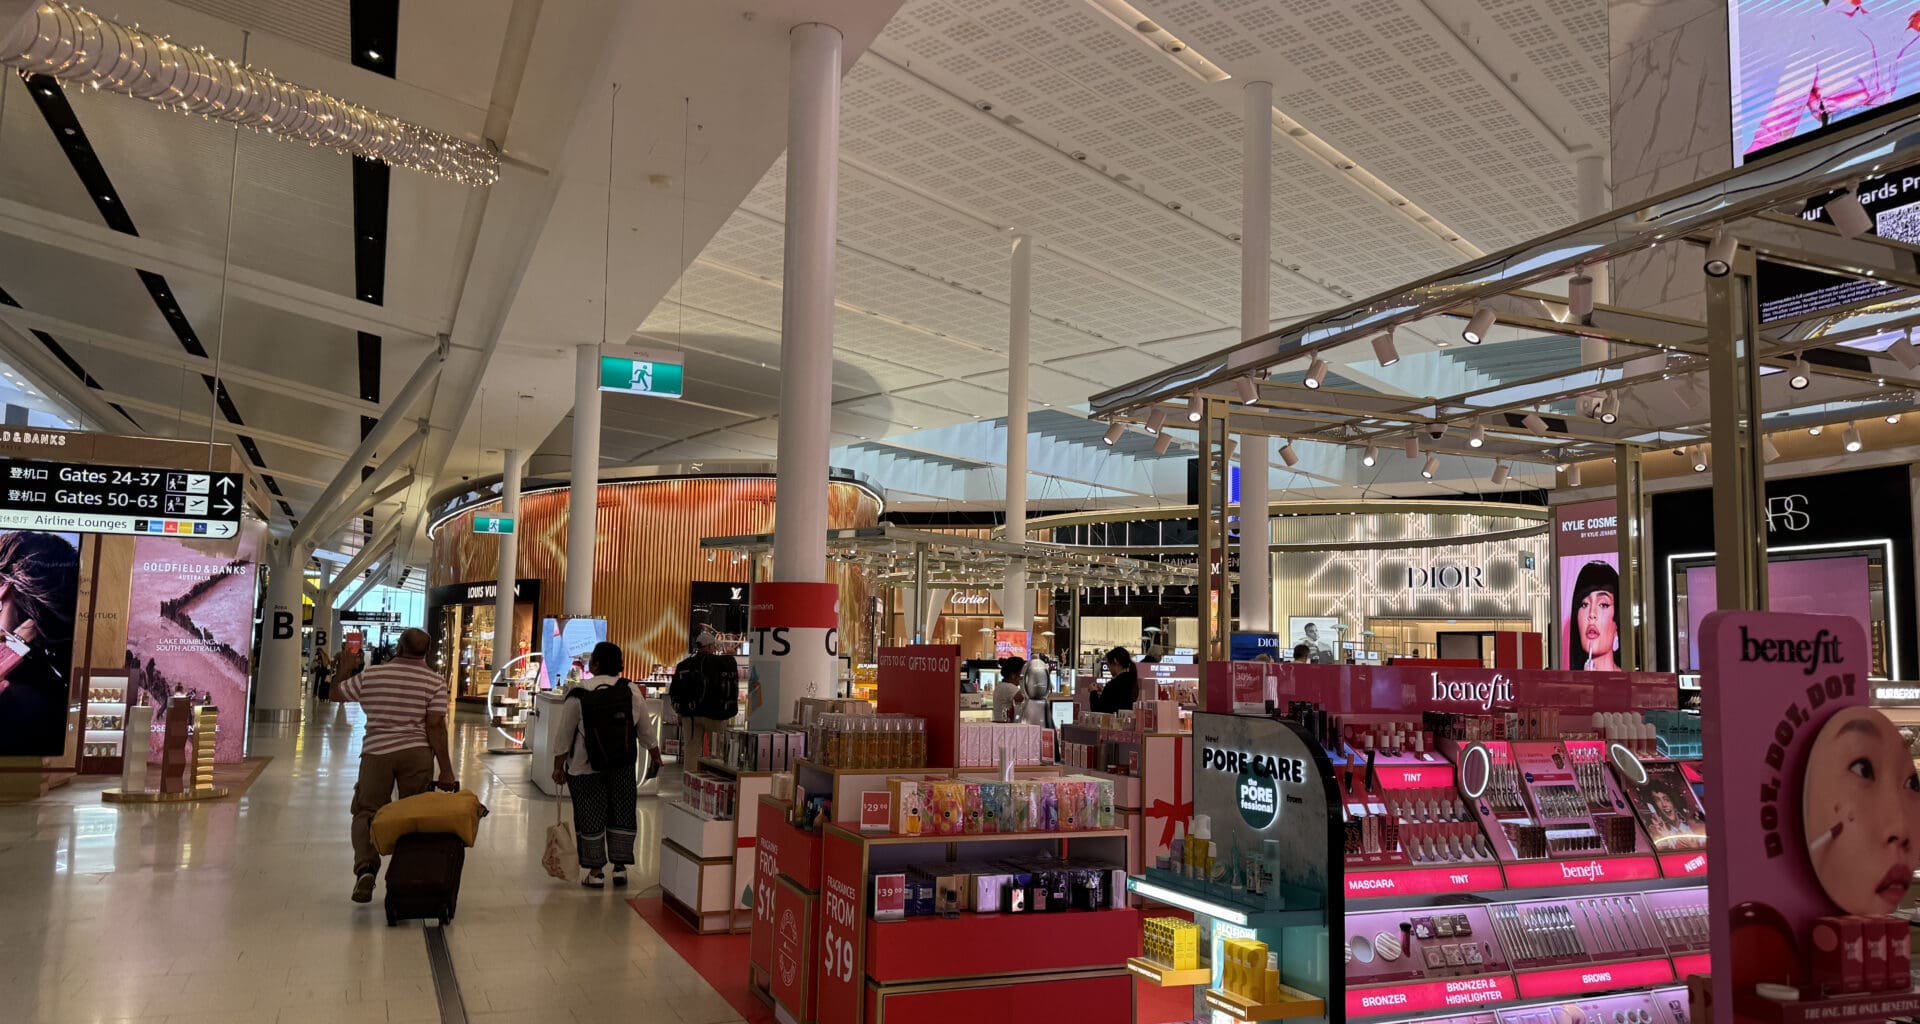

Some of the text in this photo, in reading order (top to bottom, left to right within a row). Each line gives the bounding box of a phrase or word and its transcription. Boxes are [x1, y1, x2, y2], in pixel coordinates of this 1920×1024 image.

[24, 432, 66, 446] BANKS
[9, 466, 49, 481] 登机口
[59, 467, 107, 485] Gates
[112, 470, 161, 488] 24-37
[8, 489, 46, 503] 登机口
[55, 489, 102, 507] Gates
[107, 493, 158, 510] 50-63
[35, 514, 75, 527] Airline
[78, 516, 127, 532] Lounges
[1562, 516, 1617, 532] KYLIE COSME
[144, 562, 246, 576] GOLDFIELD & BANKS
[1408, 566, 1485, 589] DIOR
[467, 585, 483, 599] LOUIS
[951, 591, 988, 604] Cartier
[273, 611, 294, 640] B
[316, 631, 327, 646] B
[156, 644, 221, 653] SOUTH AUSTRALIA
[1738, 626, 1845, 676] benefit
[880, 655, 891, 667] GIFTS
[892, 656, 899, 667] TO
[908, 656, 949, 672] GIFTS TO GO
[1431, 672, 1515, 711] benefit
[1203, 747, 1304, 784] PORE CARE
[1248, 778, 1257, 786] the
[1403, 773, 1422, 782] TINT
[1241, 784, 1273, 803] PORE
[1241, 799, 1273, 813] fessional
[1560, 860, 1604, 882] benefit
[827, 875, 856, 900] FRAGRANCES
[1348, 875, 1469, 890] MASCARA TINT
[826, 891, 855, 931] FROM
[824, 925, 853, 983] $19
[1447, 978, 1496, 993] BRONZER &
[1582, 972, 1612, 984] BROWS
[1362, 994, 1407, 1007] BRONZER
[1446, 991, 1502, 1005] HIGHLIGHTER
